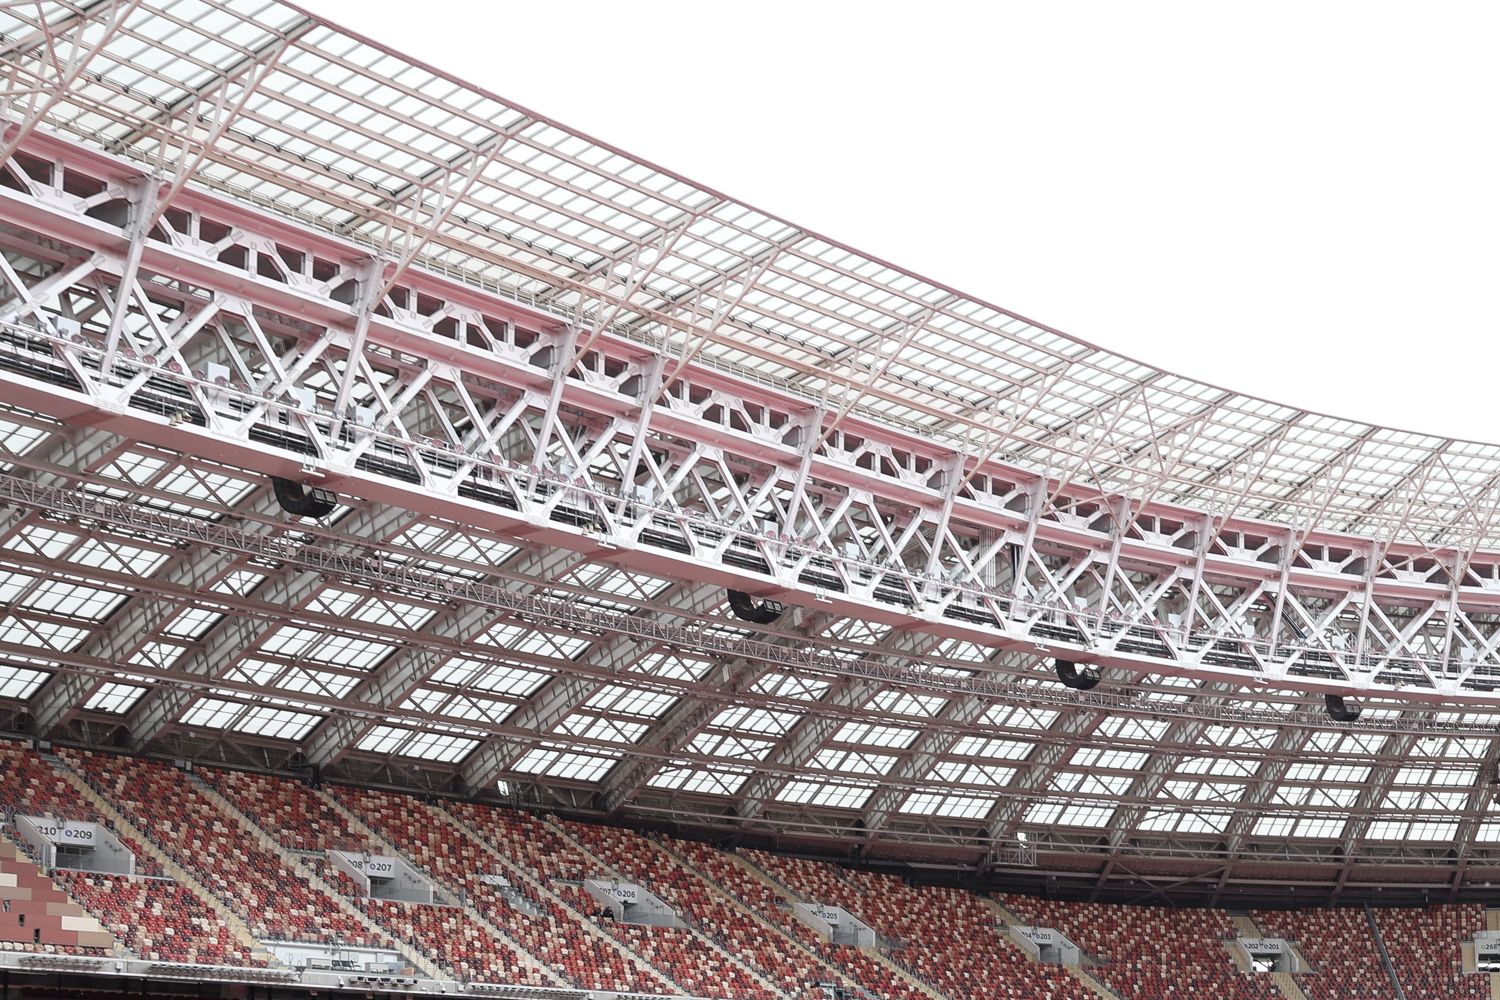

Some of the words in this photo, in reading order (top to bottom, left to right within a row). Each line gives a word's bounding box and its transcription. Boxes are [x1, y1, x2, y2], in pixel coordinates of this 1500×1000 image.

[73, 829, 93, 840] 209
[376, 863, 393, 872] 207
[622, 890, 637, 898] 206
[826, 912, 839, 921] 205
